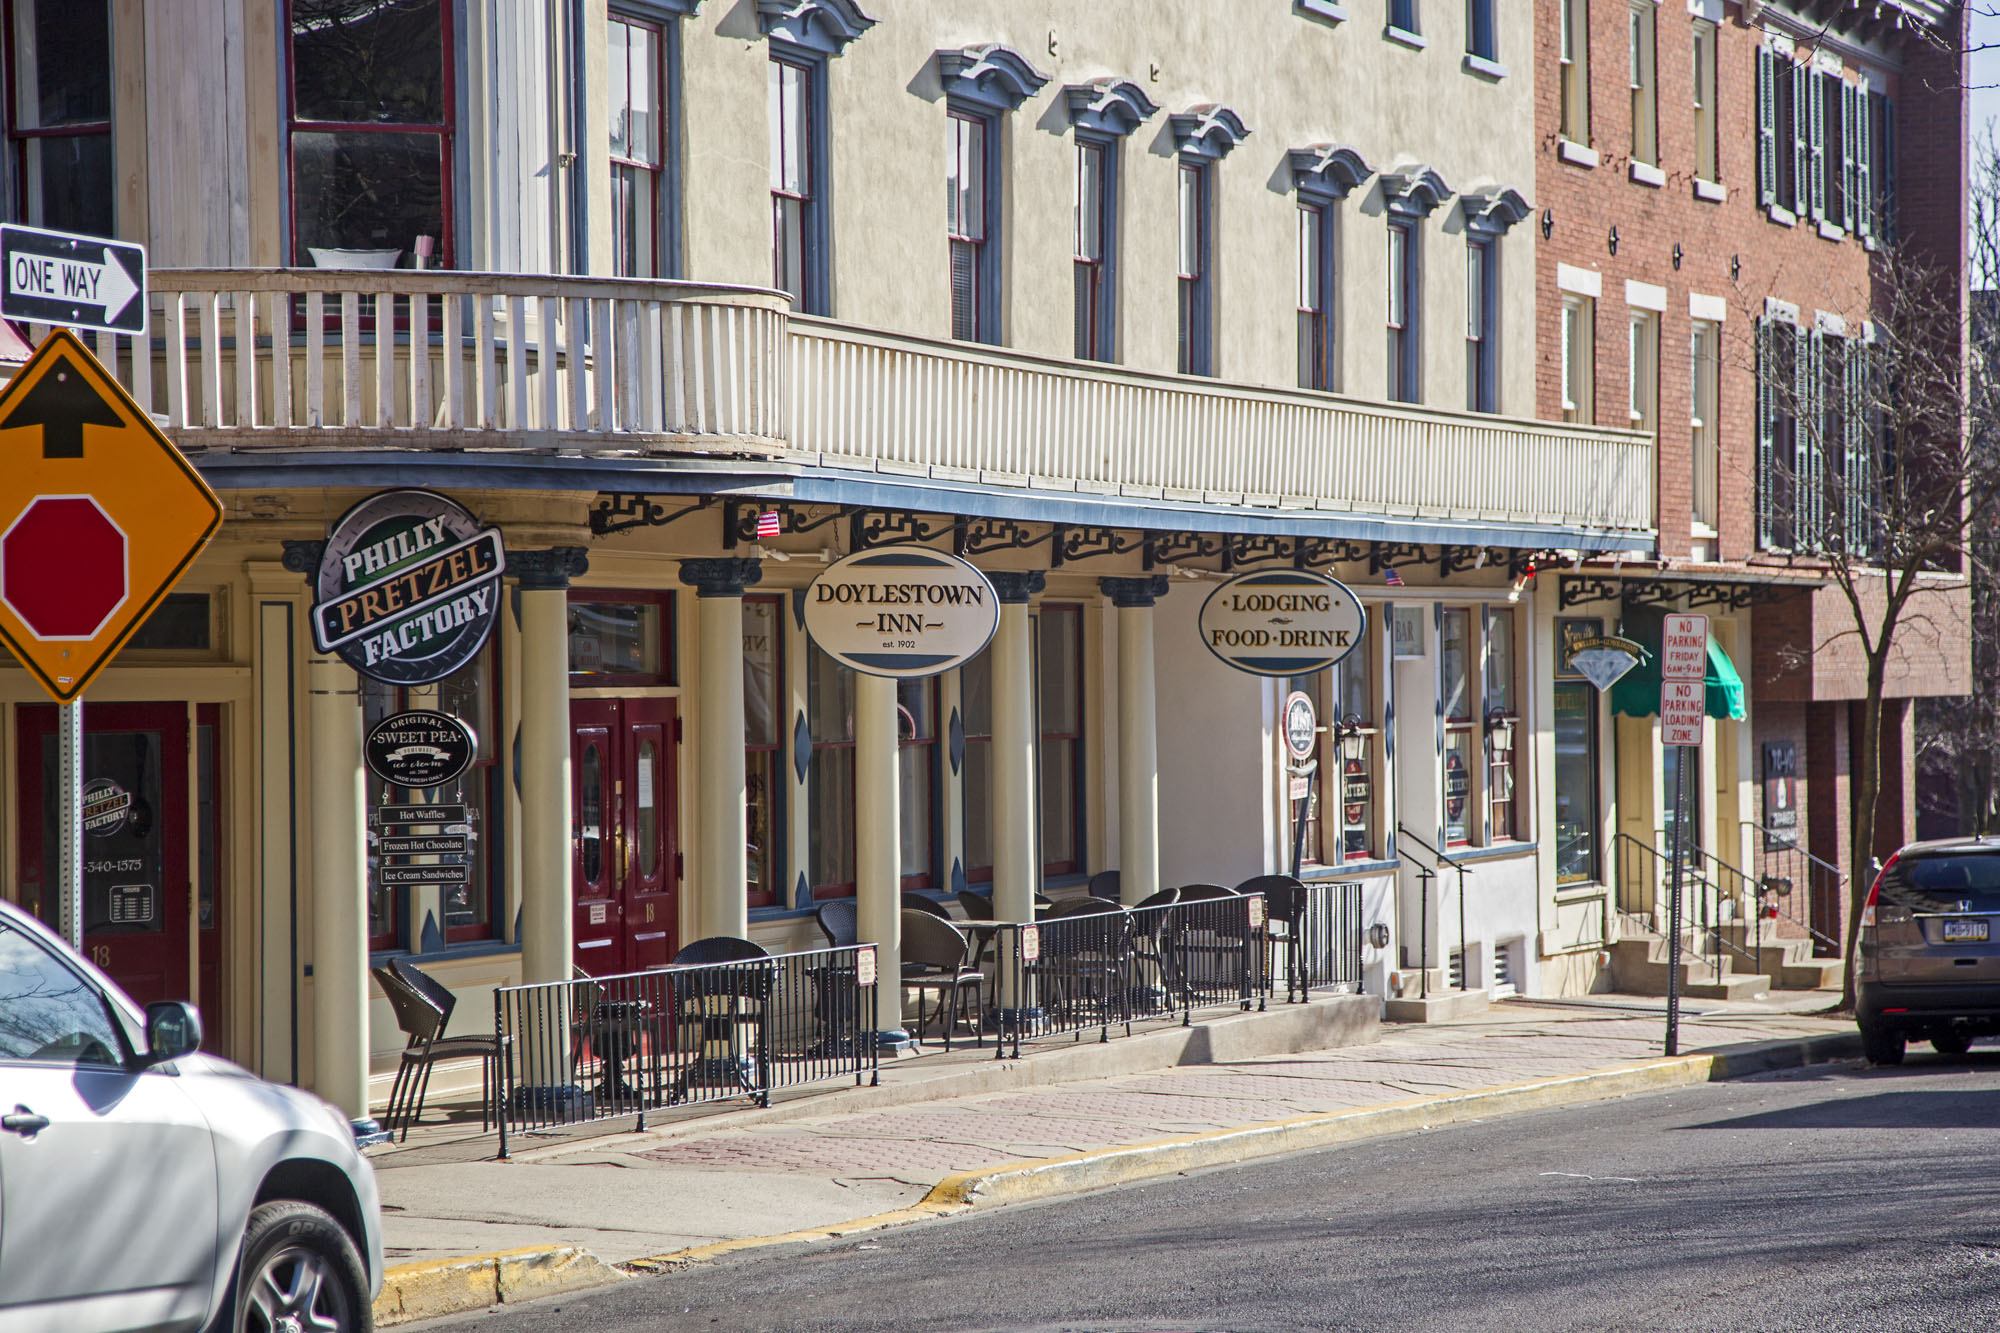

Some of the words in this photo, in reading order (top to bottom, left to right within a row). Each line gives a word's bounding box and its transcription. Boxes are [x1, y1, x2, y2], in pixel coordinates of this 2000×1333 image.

[15, 257, 54, 294] ONE
[62, 263, 101, 300] WAY
[342, 514, 446, 583] PHILLY
[337, 544, 488, 633] PRETZEL
[816, 583, 984, 605] DOYLESTOWN
[1232, 594, 1330, 612] LODGING
[362, 586, 490, 667] FACTORY
[877, 613, 924, 634] INN
[1679, 621, 1692, 633] NO
[882, 641, 894, 649] est.
[897, 640, 915, 649] 1902
[1668, 635, 1702, 648] PARKING
[1670, 651, 1699, 661] FRIDAY
[1676, 685, 1691, 698] NO
[1665, 700, 1701, 713] PARKING
[390, 716, 443, 730] ORIGINAL
[1665, 714, 1700, 726] LOADING
[376, 731, 427, 744] SWEET
[430, 731, 458, 743] PEA
[1672, 730, 1693, 741] ZONE
[428, 773, 443, 782] DAILY
[85, 796, 126, 816] RETZEL
[85, 809, 126, 831] FACTORY
[399, 811, 414, 820] Hot
[416, 810, 446, 819] Waffles
[383, 841, 409, 851] Frozen
[410, 841, 424, 850] Hot
[425, 840, 462, 849] Chocolate
[384, 871, 396, 880] Ice
[397, 871, 421, 880] Cream
[421, 870, 464, 880] Sandwiches
[92, 945, 110, 967] 18
